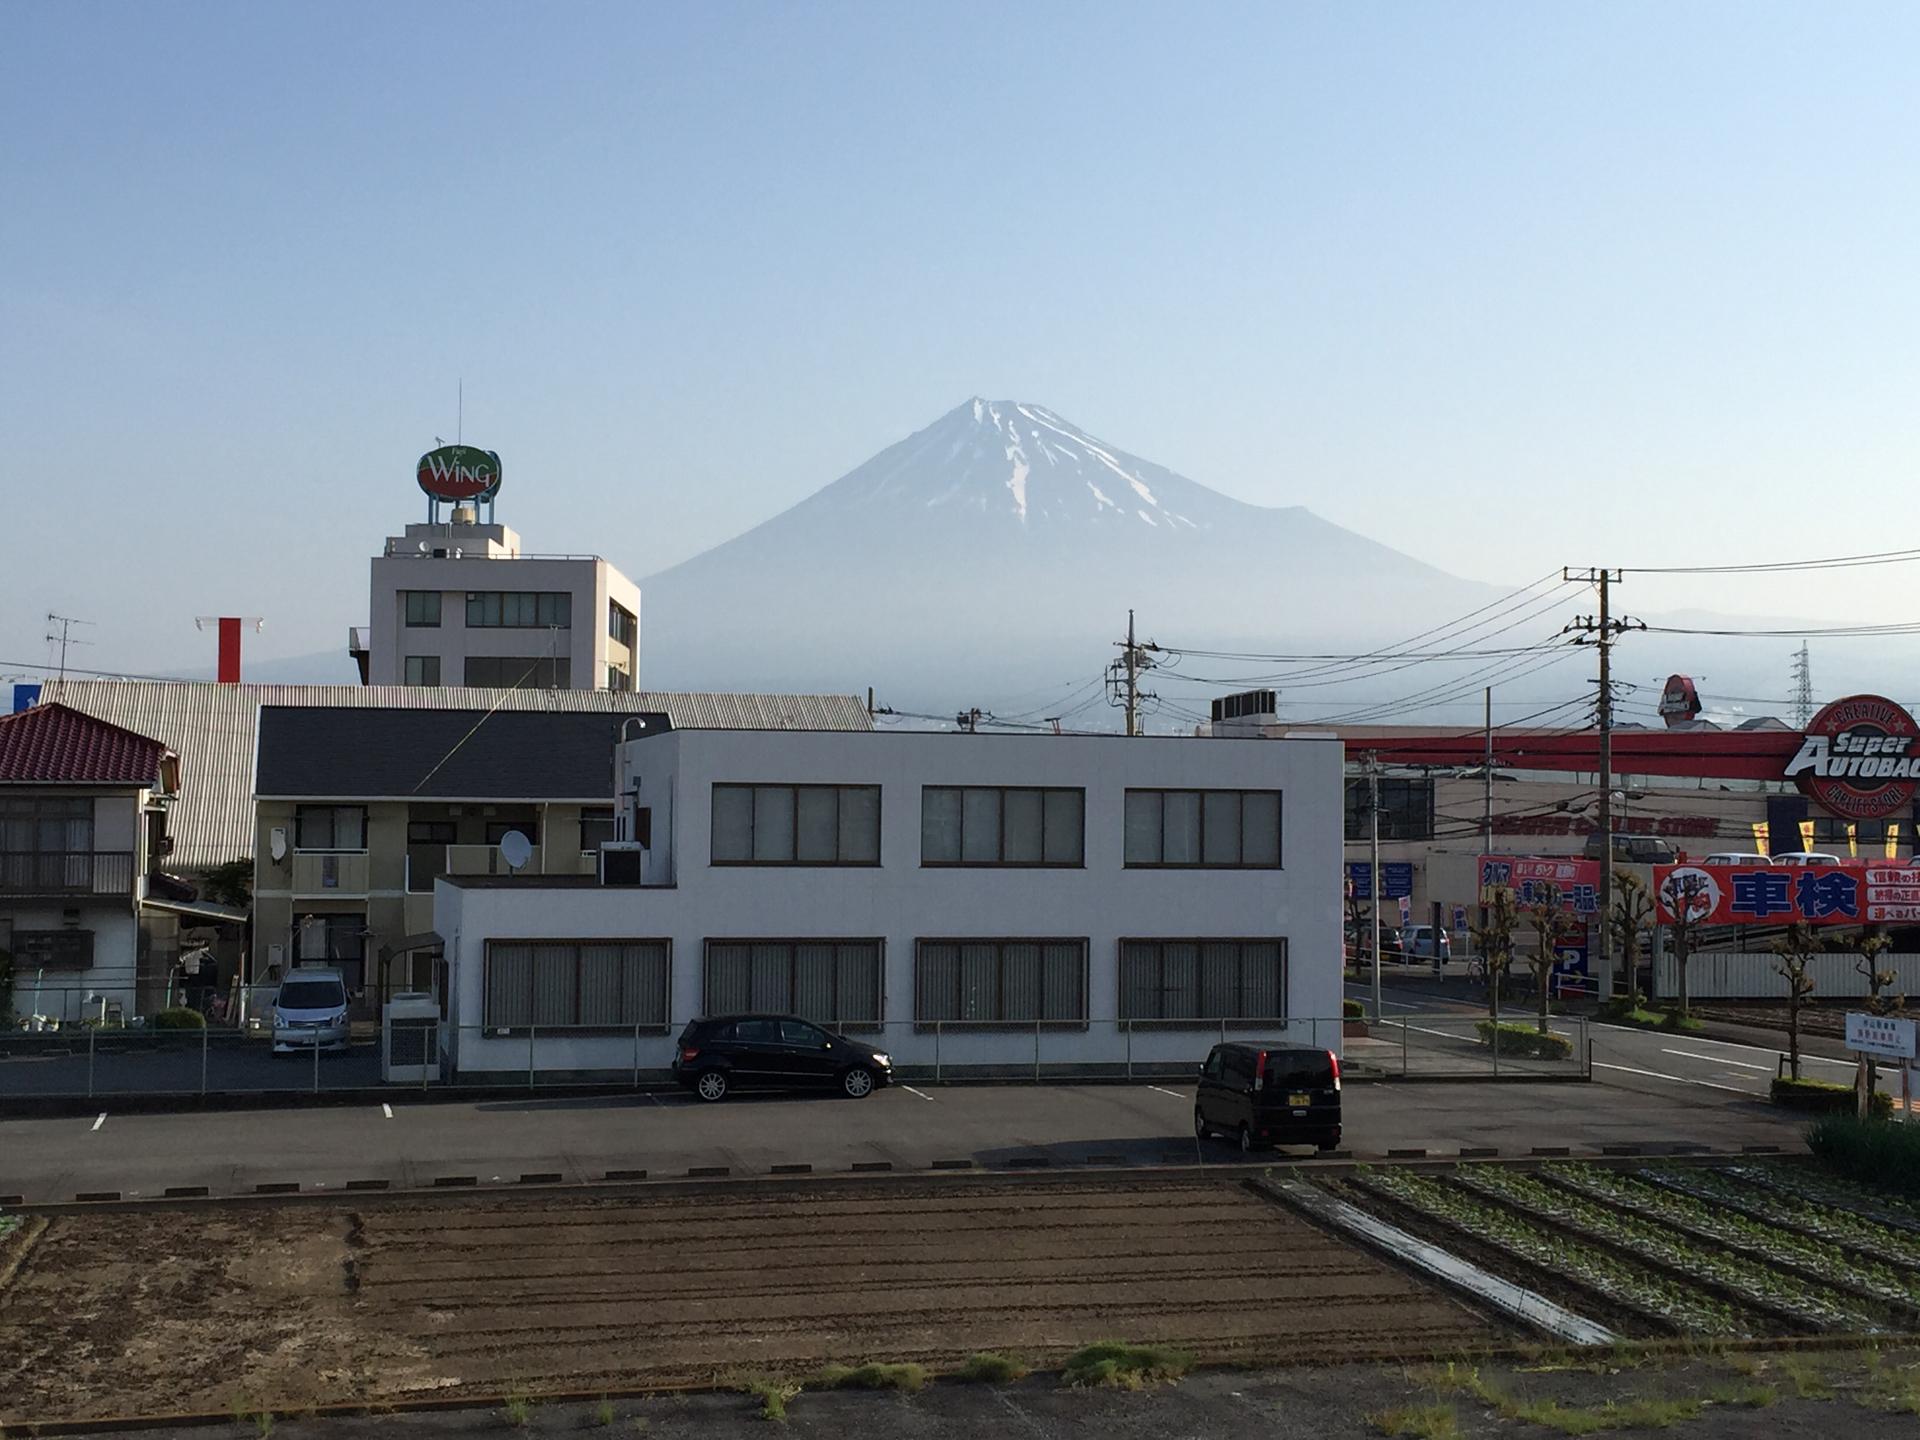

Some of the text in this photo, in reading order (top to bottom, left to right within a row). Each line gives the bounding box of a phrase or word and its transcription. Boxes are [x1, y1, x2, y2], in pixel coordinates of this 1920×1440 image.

[1834, 703, 1897, 724] CREATIVE
[1834, 732, 1913, 756] Super
[1730, 871, 1860, 918] 車検
[1563, 949, 1581, 970] P
